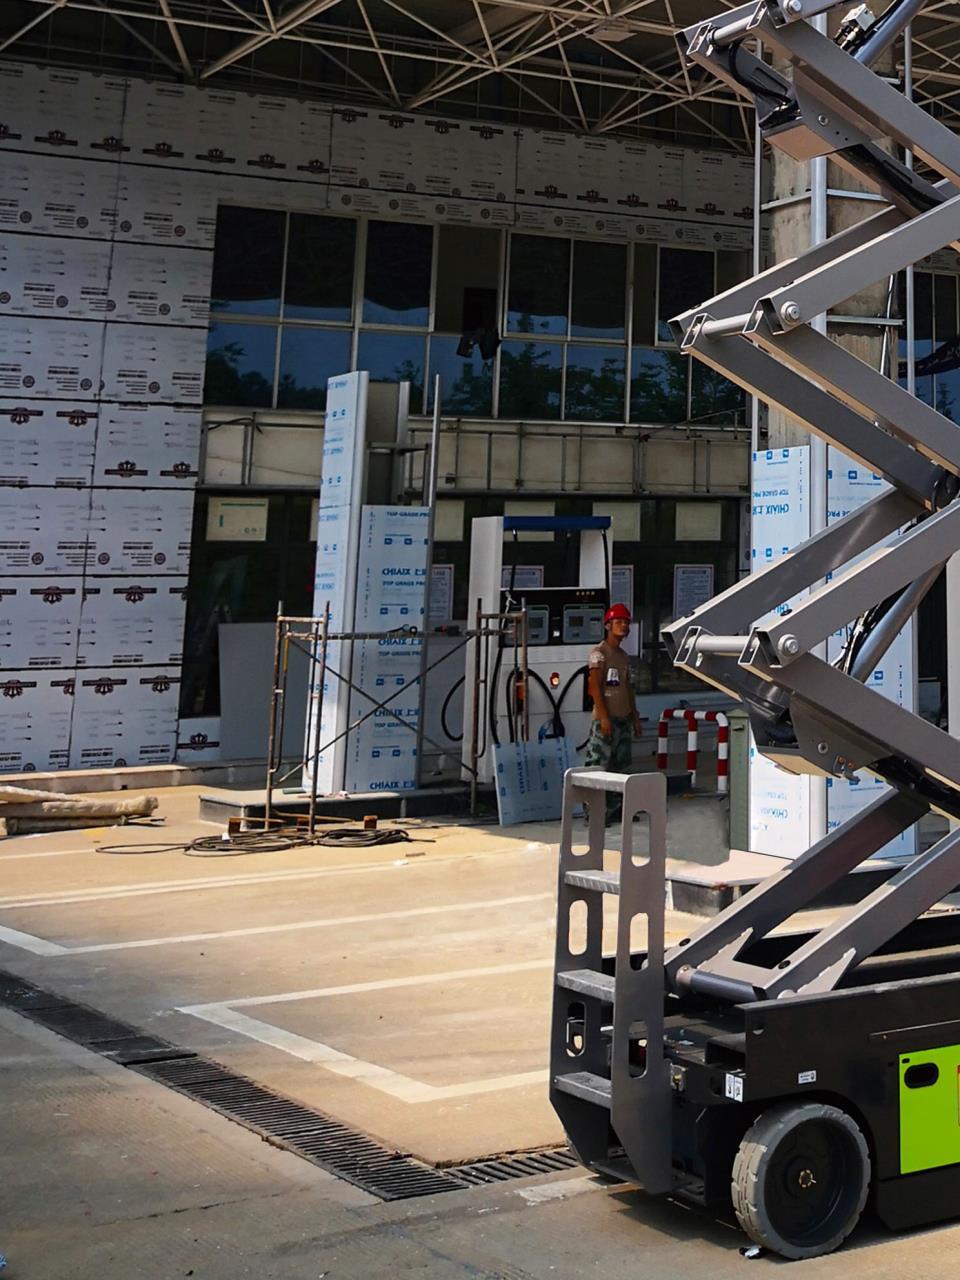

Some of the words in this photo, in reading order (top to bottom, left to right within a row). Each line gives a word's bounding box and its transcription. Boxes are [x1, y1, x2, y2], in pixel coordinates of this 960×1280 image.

[382, 568, 411, 576] CHIAIX
[378, 638, 407, 646] CHIAIX
[369, 781, 399, 790] CHIAIX
